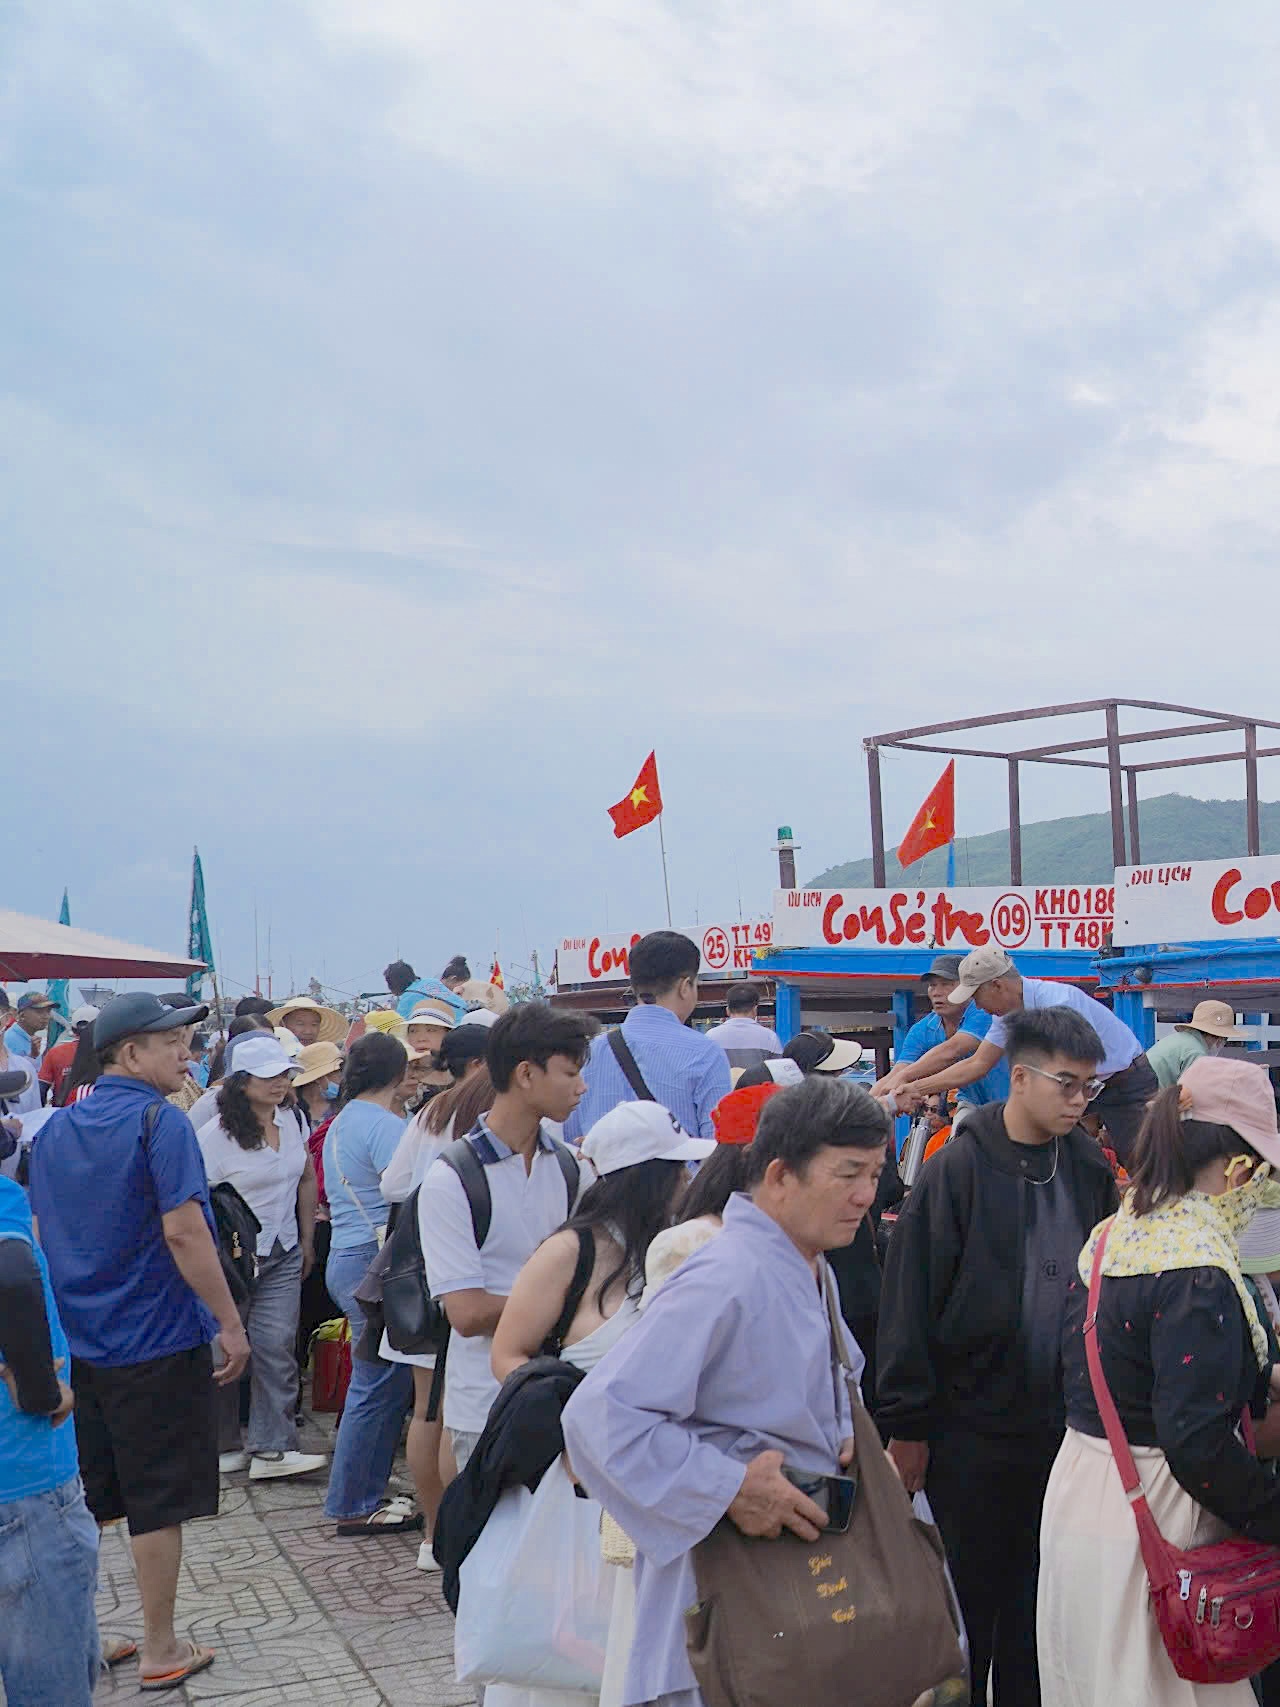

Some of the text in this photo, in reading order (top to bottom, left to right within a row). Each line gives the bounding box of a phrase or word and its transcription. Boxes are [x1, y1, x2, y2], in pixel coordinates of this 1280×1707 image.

[1131, 866, 1192, 886] DU LỊCH
[788, 891, 801, 907] DU
[997, 903, 1026, 937] 09
[754, 922, 773, 943] 49
[706, 936, 725, 960] 25
